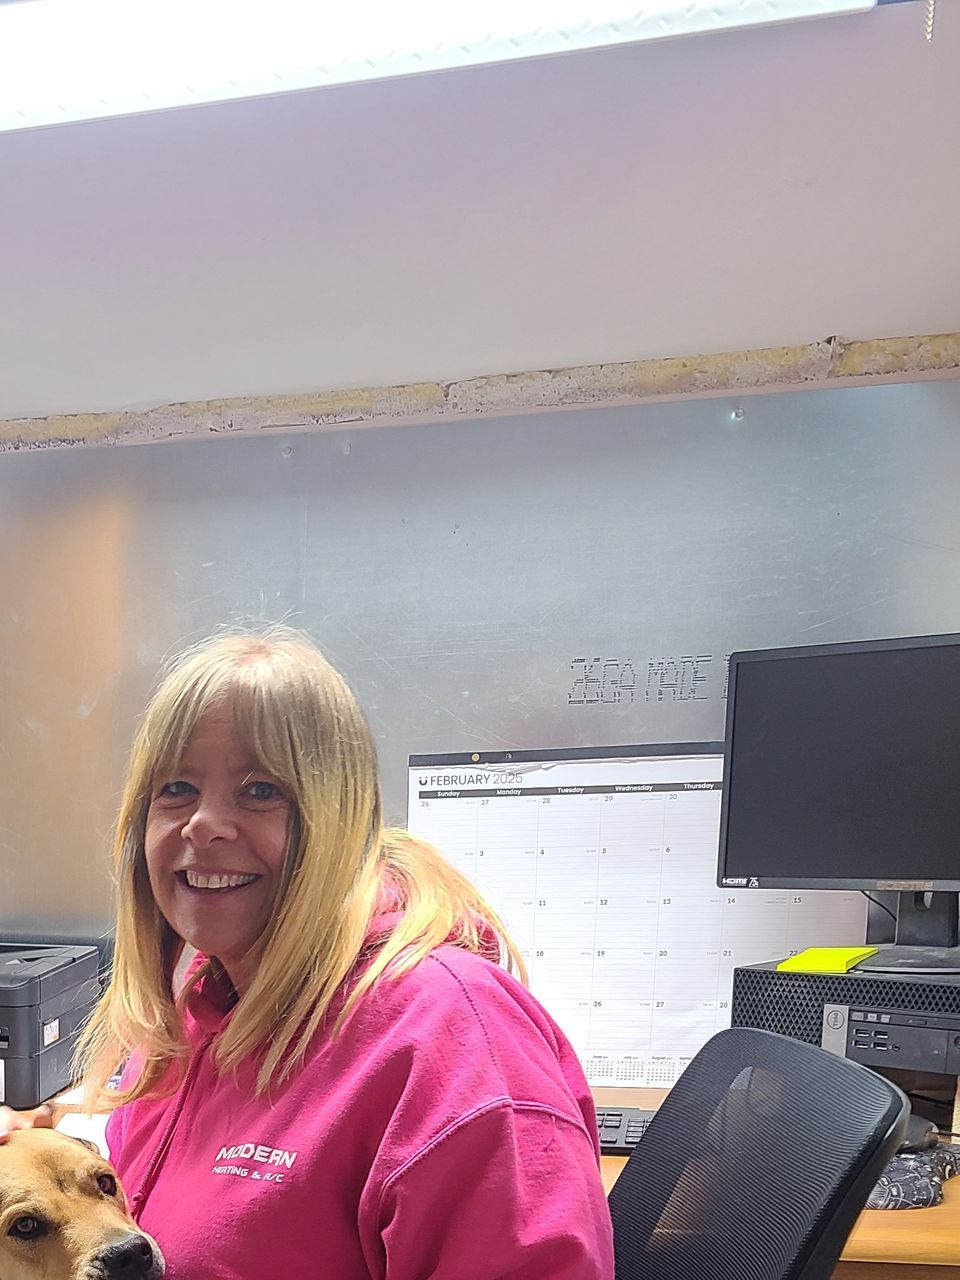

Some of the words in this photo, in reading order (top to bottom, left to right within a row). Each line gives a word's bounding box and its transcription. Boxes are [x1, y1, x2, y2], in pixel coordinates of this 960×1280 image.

[430, 774, 491, 786] FEBRUARY
[492, 773, 523, 785] 2025
[615, 784, 654, 792] Wednesday
[683, 782, 715, 790] Thursday
[722, 877, 748, 885] HDMI
[793, 896, 802, 904] 15
[215, 1143, 298, 1169] MODERN
[211, 1165, 249, 1177] HEATING
[251, 1169, 262, 1180] &
[263, 1172, 285, 1183] A/C
